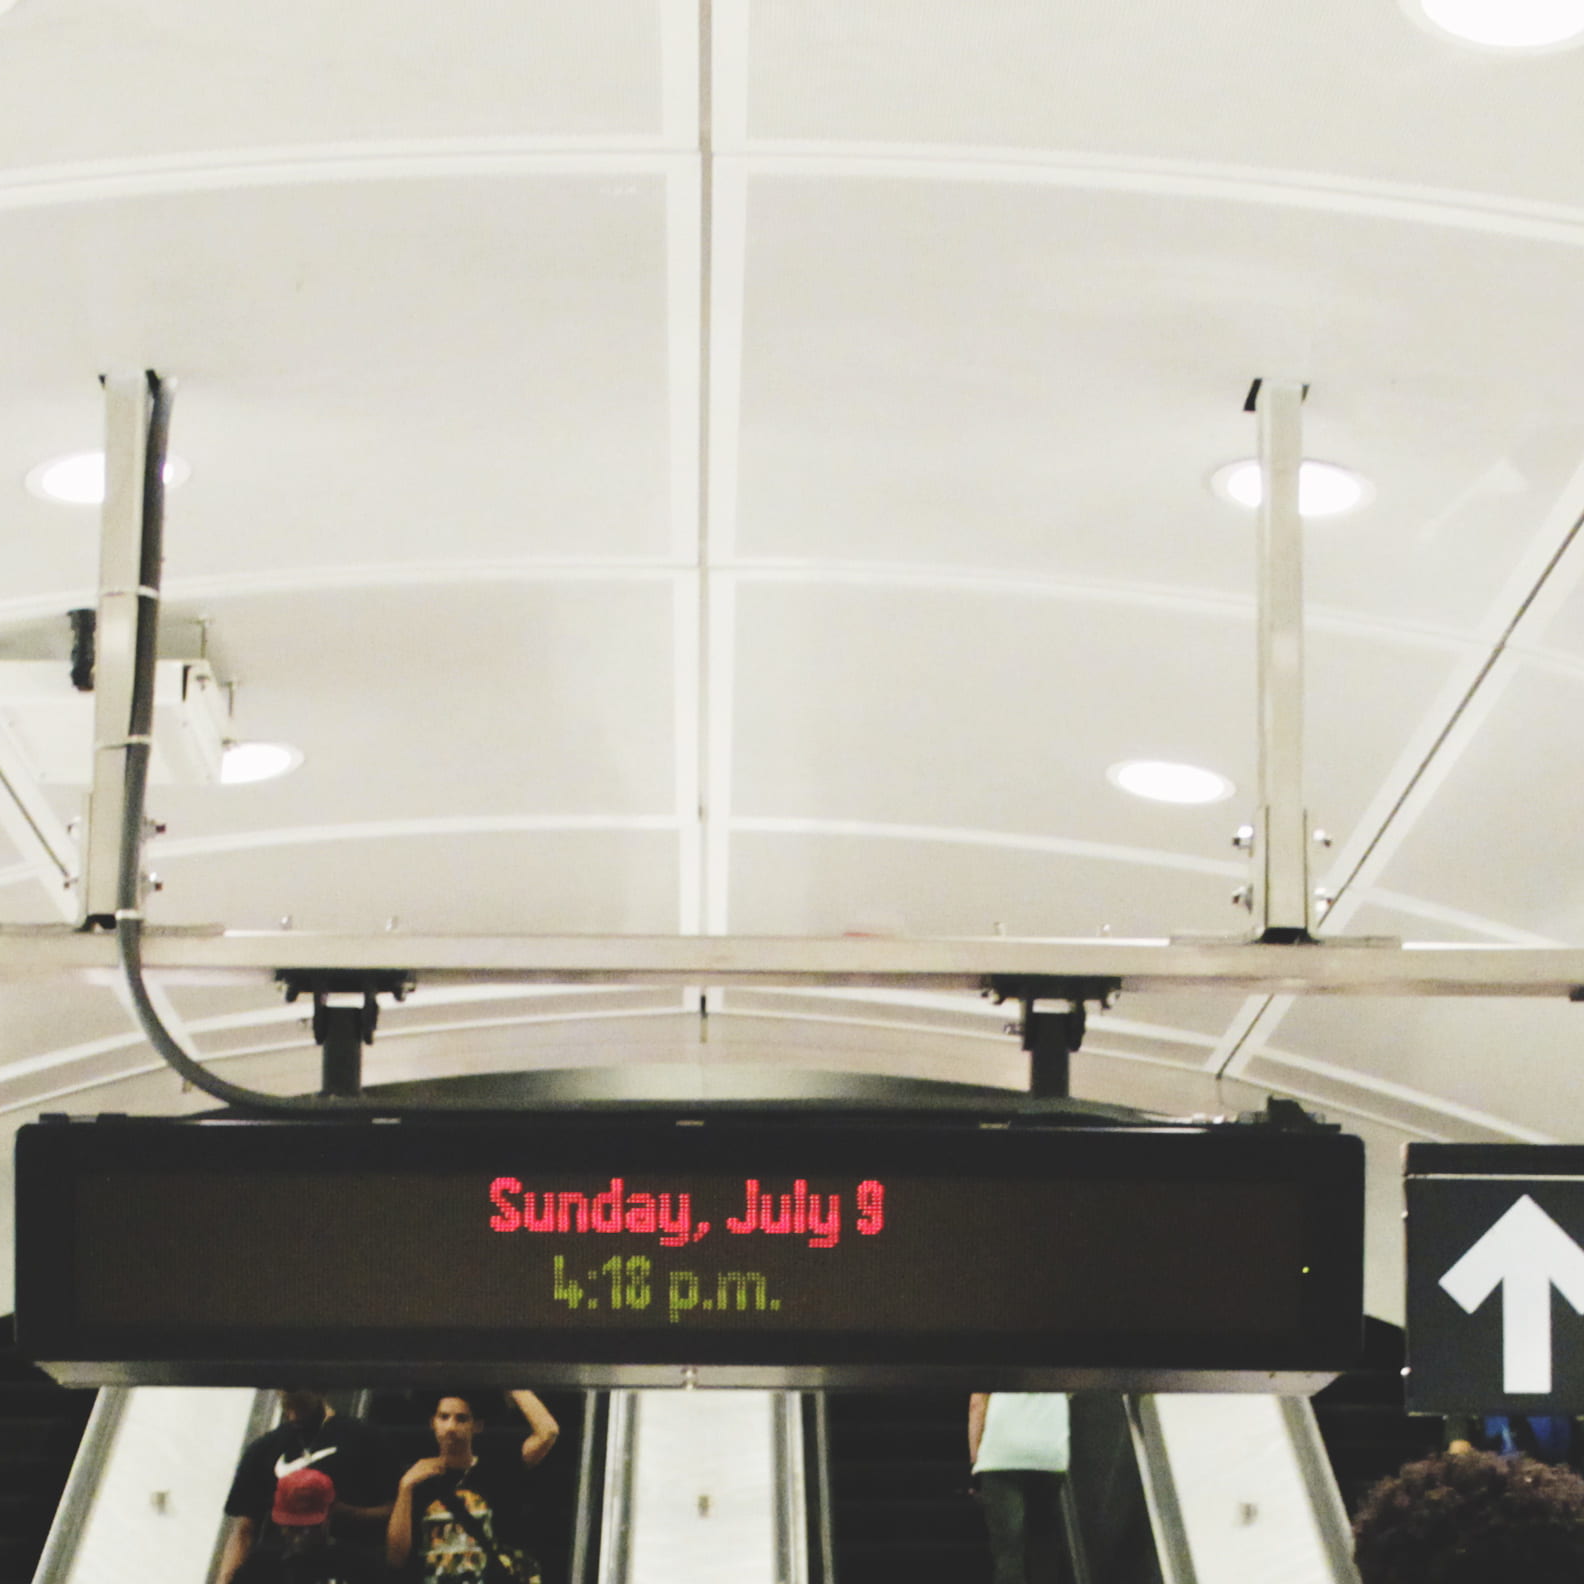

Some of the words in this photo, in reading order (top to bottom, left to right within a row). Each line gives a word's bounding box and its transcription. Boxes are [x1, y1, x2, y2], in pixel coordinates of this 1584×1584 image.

[489, 1176, 711, 1248] Sunday,
[726, 1178, 842, 1249] July
[856, 1179, 886, 1236] 9
[553, 1255, 652, 1310] 4:18
[669, 1271, 782, 1323] p.m.
